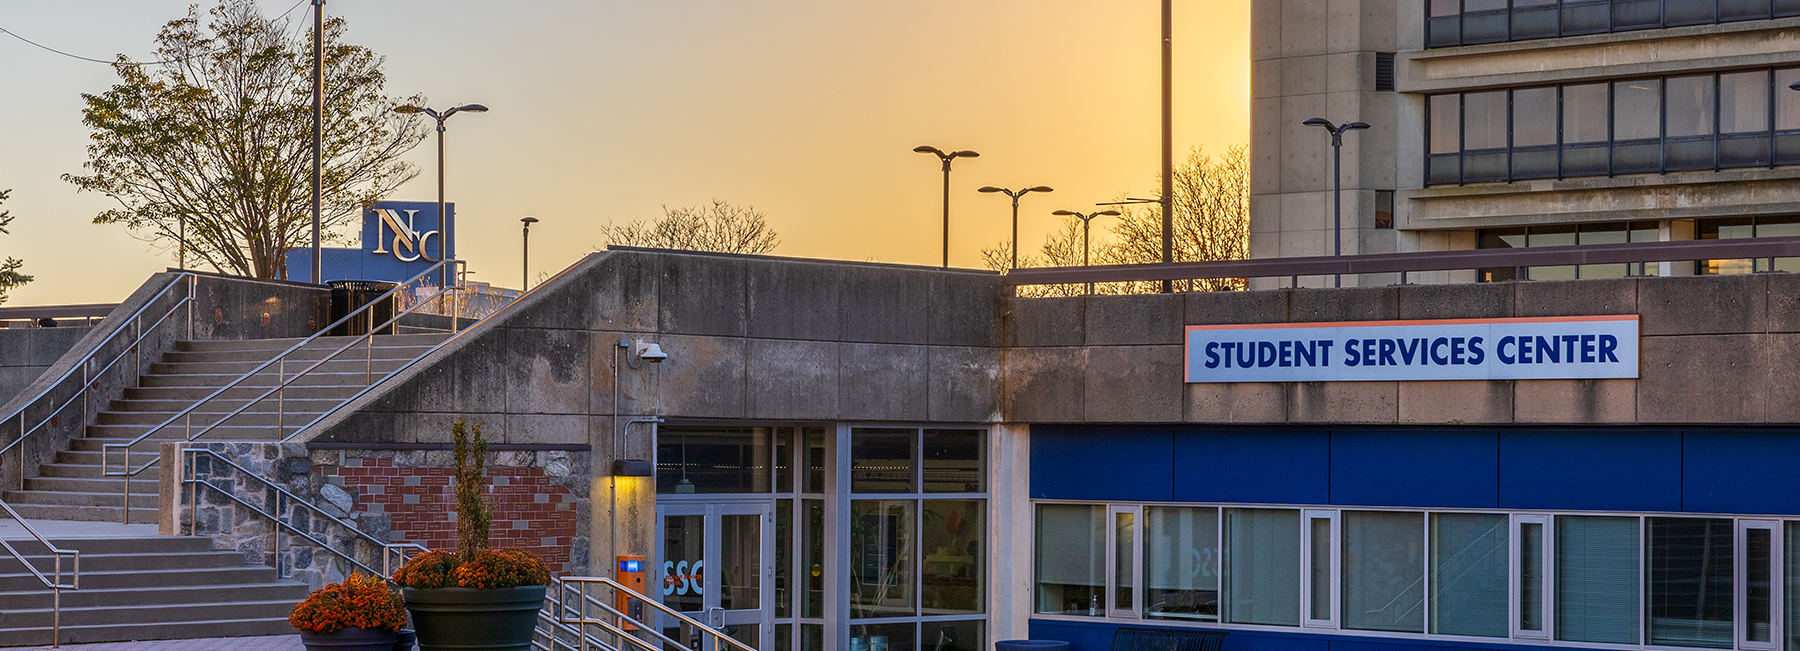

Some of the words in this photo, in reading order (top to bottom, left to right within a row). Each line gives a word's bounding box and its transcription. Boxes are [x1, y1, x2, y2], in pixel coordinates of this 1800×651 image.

[1204, 340, 1334, 369] STUDENT
[1343, 336, 1485, 367] SERVICES
[1496, 334, 1620, 365] CENTER
